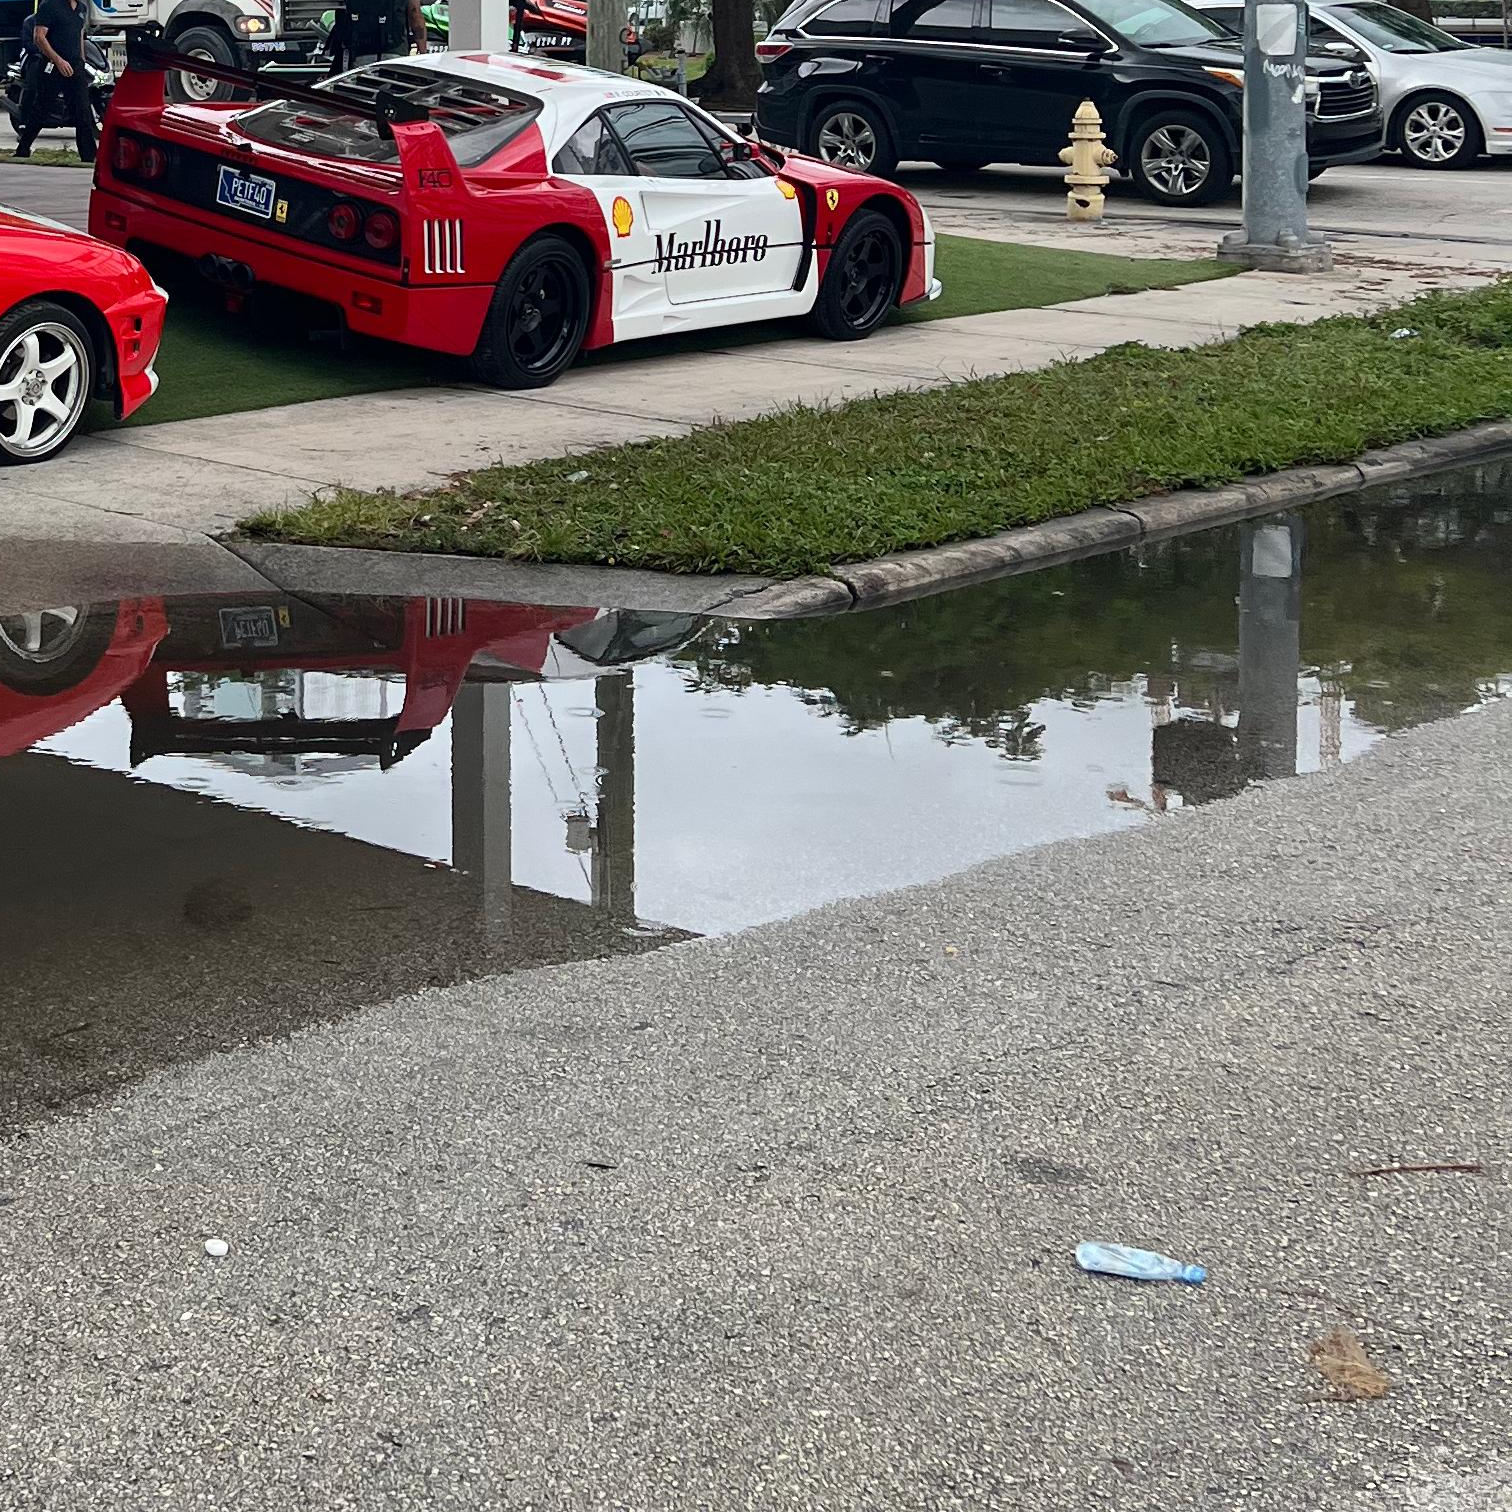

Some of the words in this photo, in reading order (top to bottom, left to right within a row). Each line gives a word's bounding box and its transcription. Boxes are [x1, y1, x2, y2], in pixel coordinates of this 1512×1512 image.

[231, 177, 268, 204] PETF40
[418, 168, 452, 188] F40
[651, 219, 768, 275] Marlboro
